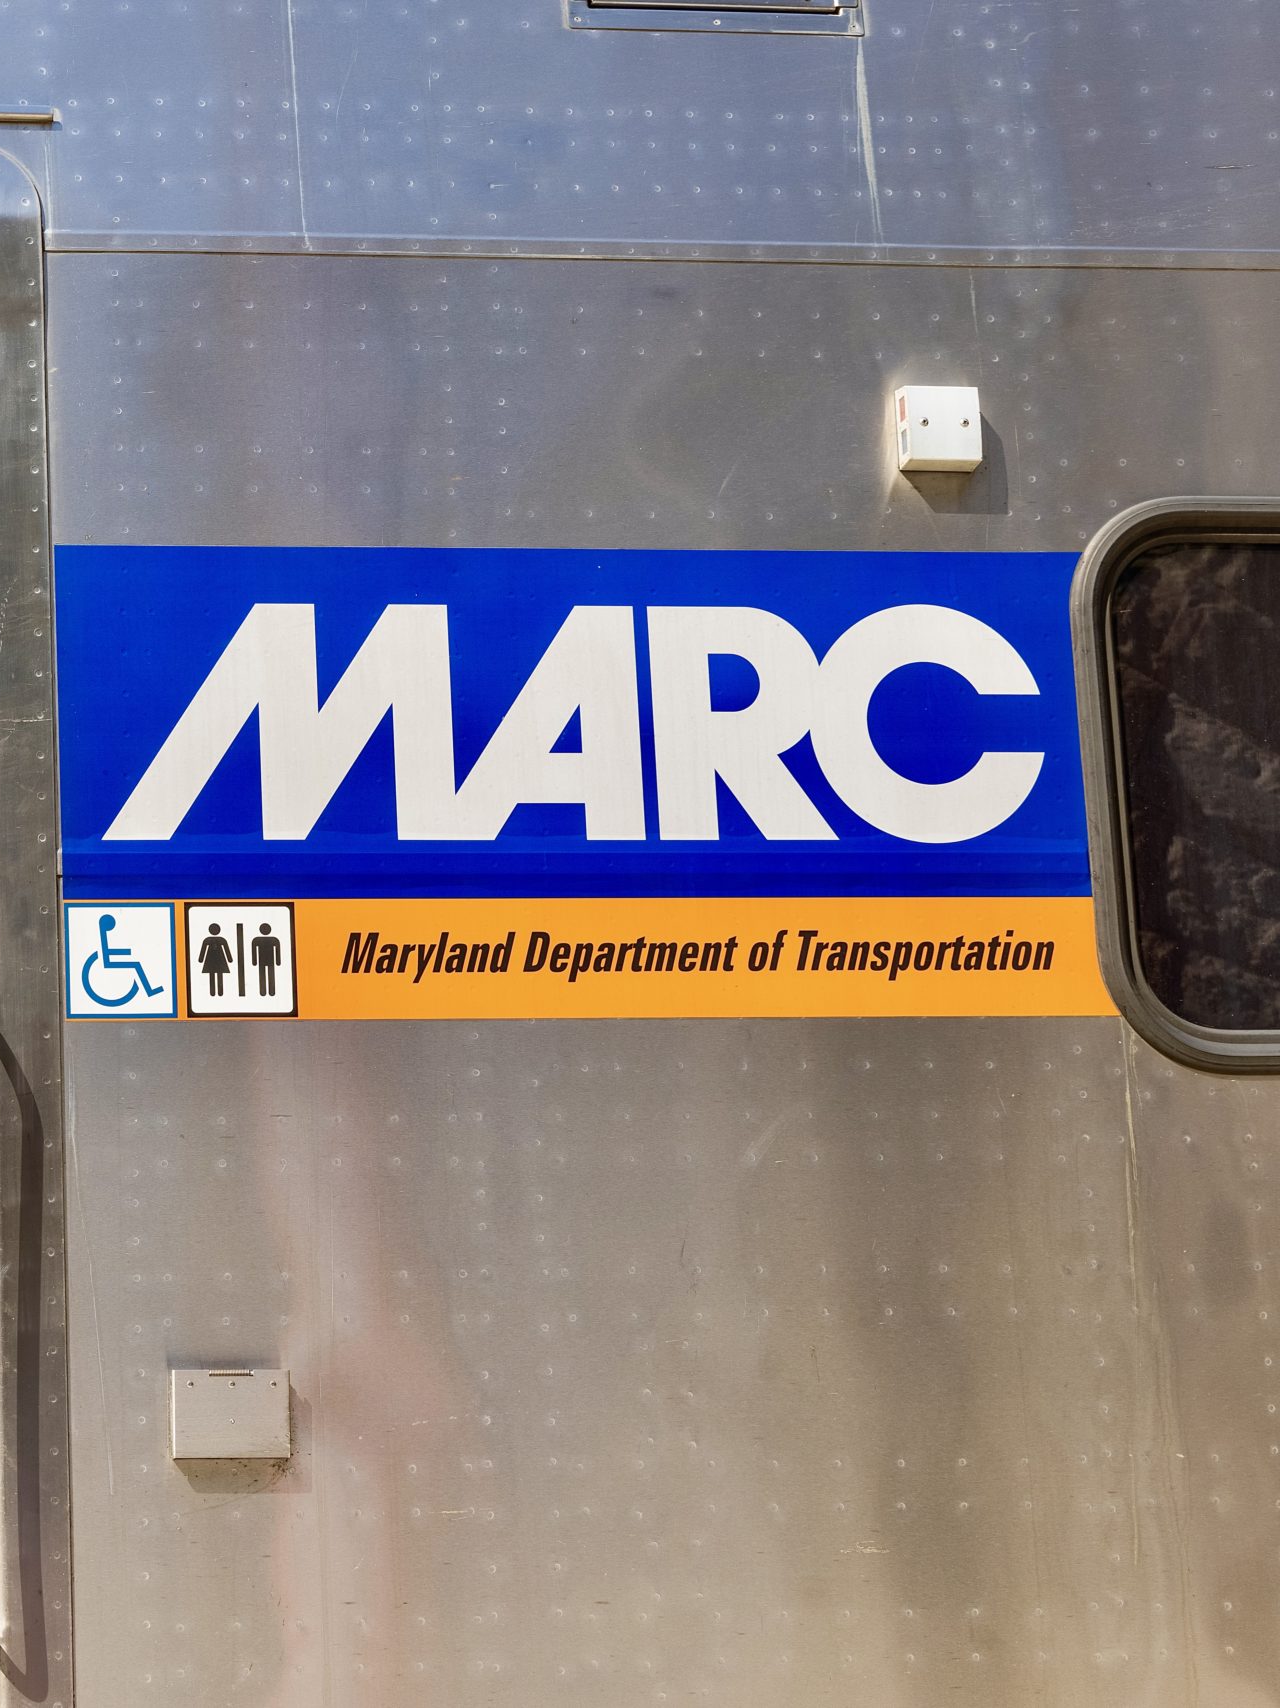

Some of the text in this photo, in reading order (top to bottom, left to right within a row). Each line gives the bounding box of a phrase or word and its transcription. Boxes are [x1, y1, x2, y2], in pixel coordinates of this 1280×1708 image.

[102, 604, 1044, 844] MARC
[340, 929, 1055, 984] Maryland Department of Transportation
